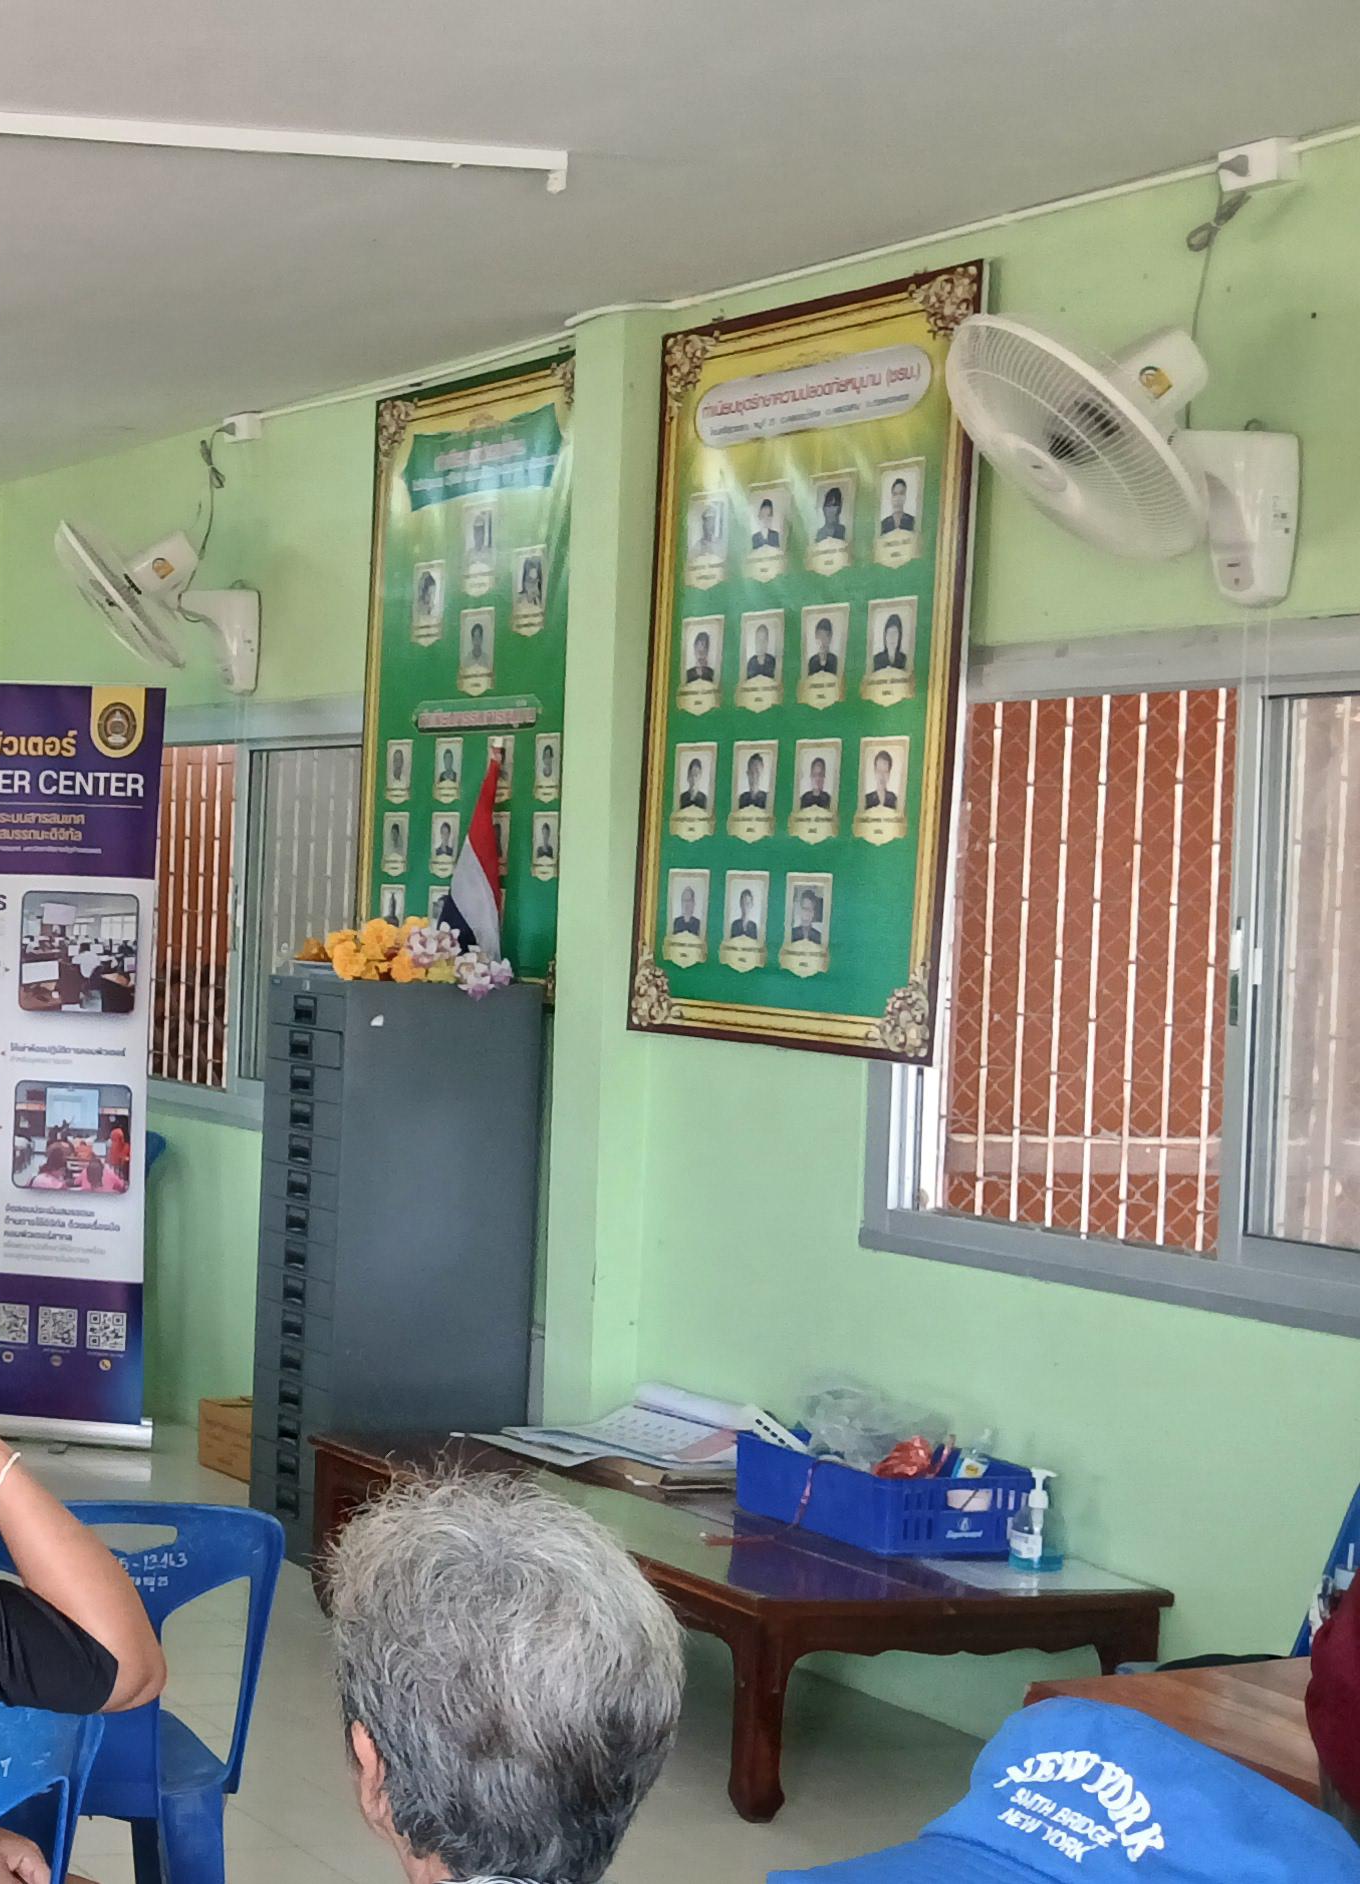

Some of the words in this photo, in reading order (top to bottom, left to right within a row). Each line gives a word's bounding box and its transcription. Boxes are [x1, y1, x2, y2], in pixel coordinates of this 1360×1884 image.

[38, 770, 145, 797] CENTER
[993, 1749, 1102, 1789] NEW
[1081, 1760, 1166, 1863] YORK
[997, 1807, 1044, 1834] NEW
[1042, 1825, 1098, 1864] YORK
